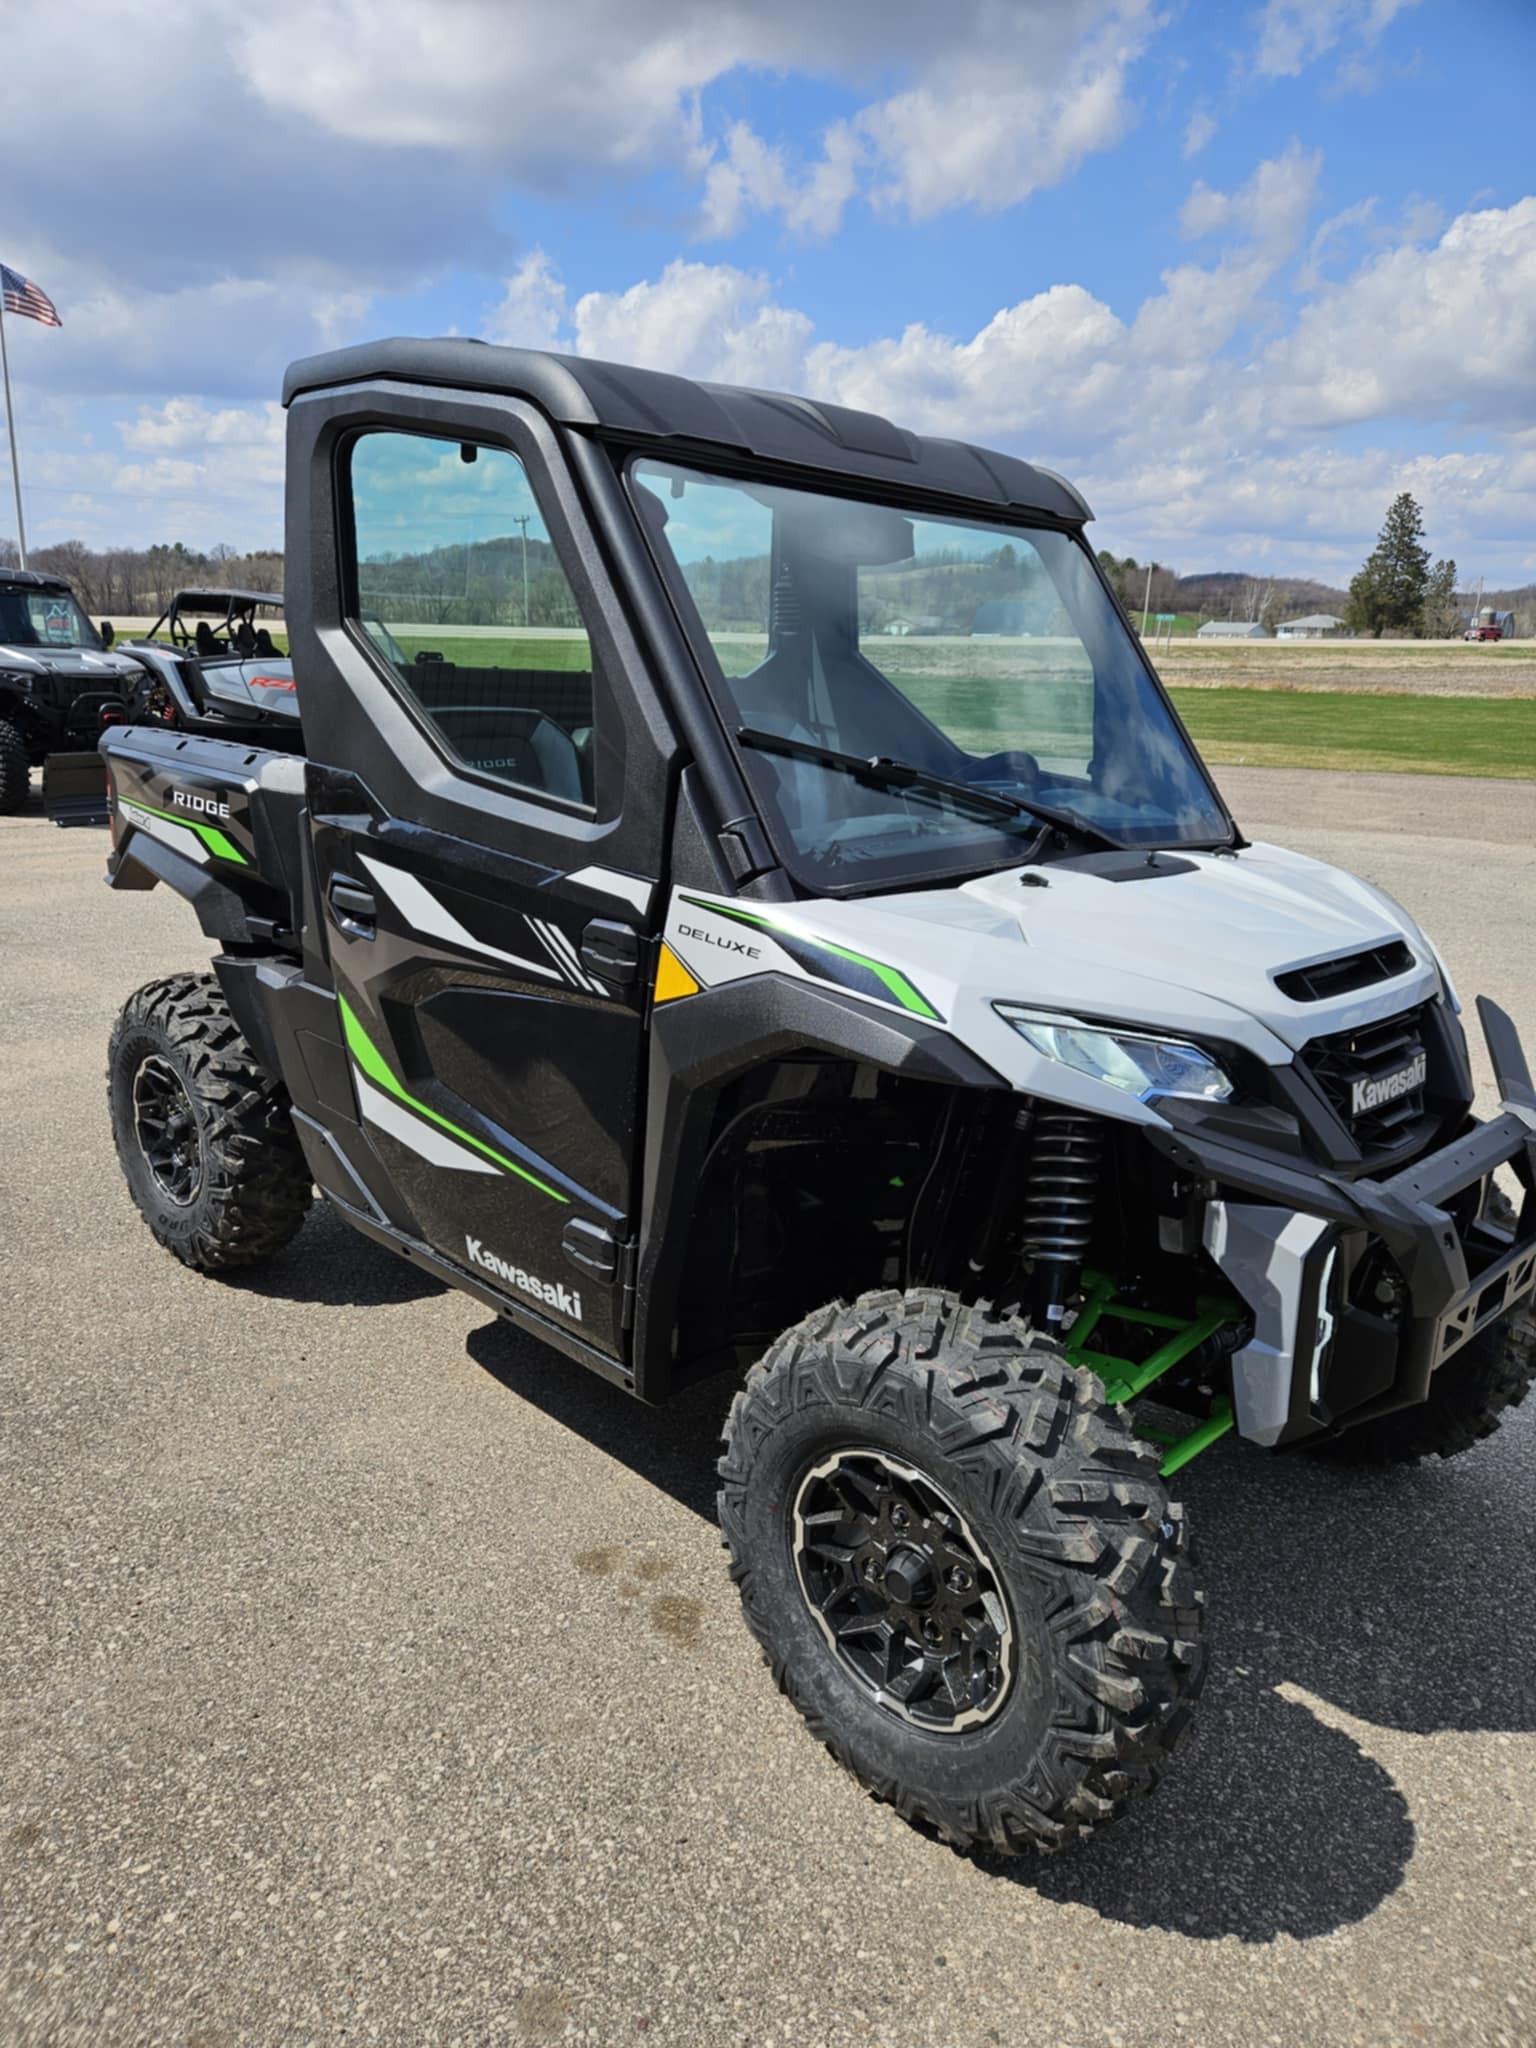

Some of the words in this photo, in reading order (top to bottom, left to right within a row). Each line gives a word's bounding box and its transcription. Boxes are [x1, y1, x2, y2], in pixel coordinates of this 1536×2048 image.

[172, 790, 231, 819] RIDGE
[677, 923, 762, 960] DELUXE
[1351, 1052, 1427, 1115] Kawasaki
[464, 1233, 583, 1321] Kawasaki
